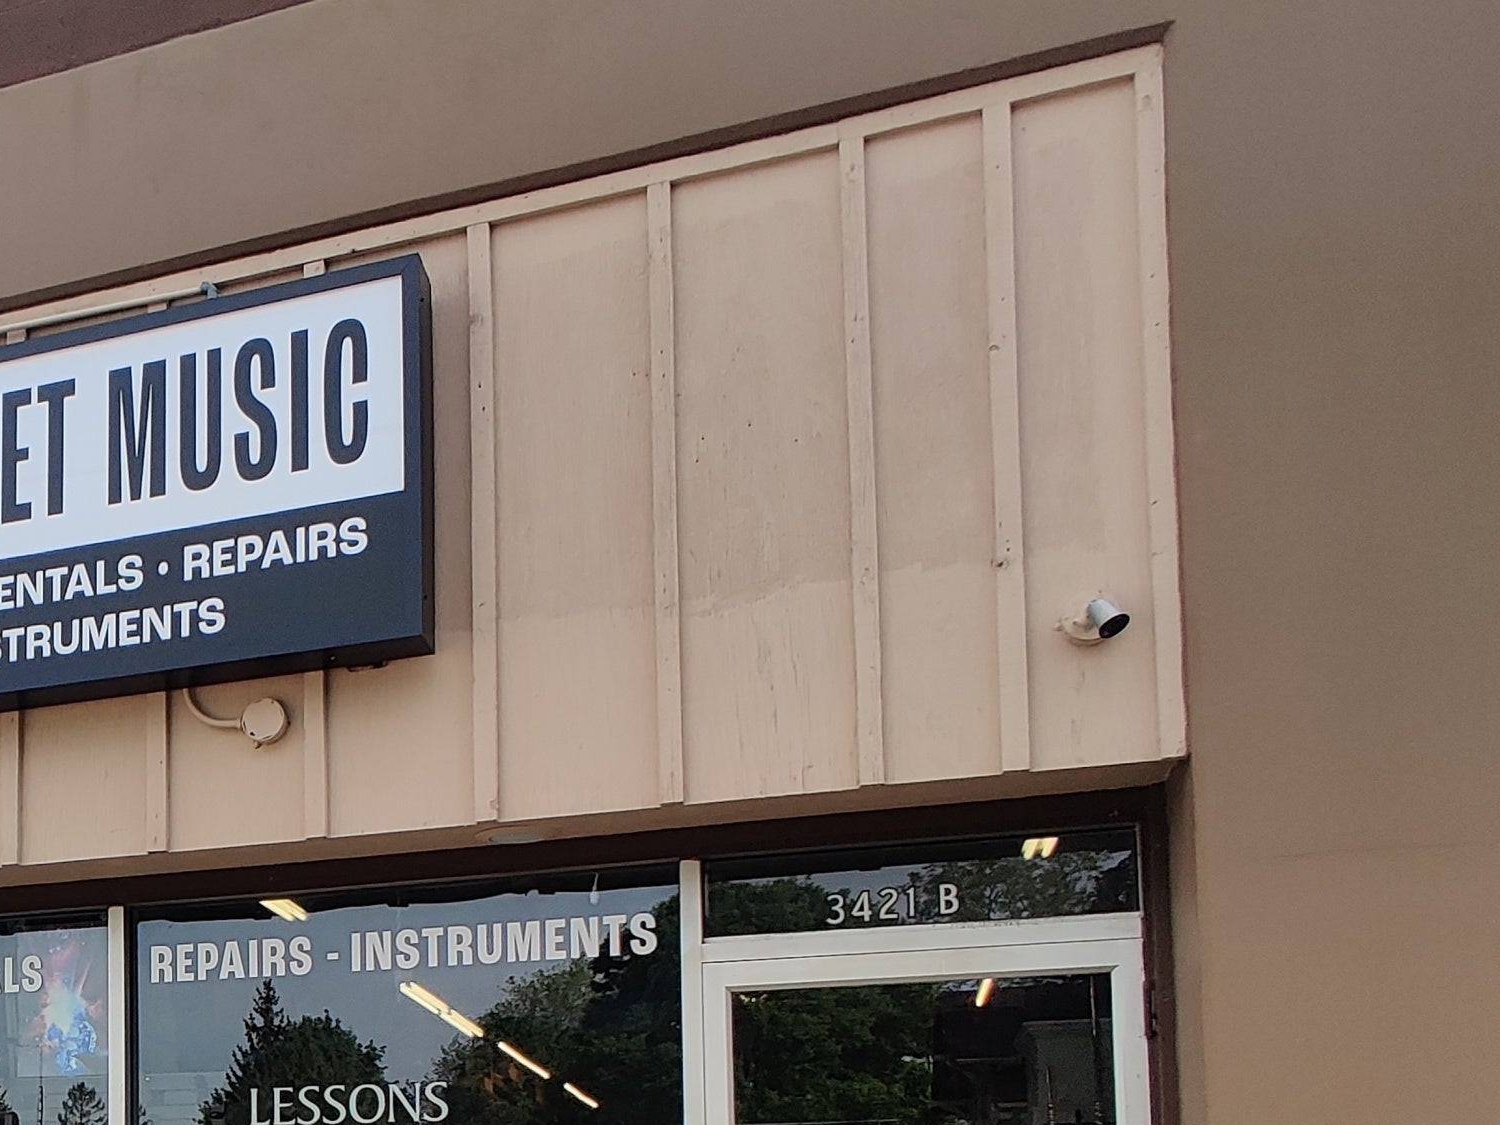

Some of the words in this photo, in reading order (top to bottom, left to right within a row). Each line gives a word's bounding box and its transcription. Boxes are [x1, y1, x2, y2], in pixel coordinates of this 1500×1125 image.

[107, 317, 370, 506] MUSIC
[183, 517, 369, 582] REPAIRS
[825, 888, 918, 925] 3421
[939, 883, 960, 915] B
[150, 936, 313, 984] REPAIRS
[351, 912, 658, 973] INSTRUMENTS
